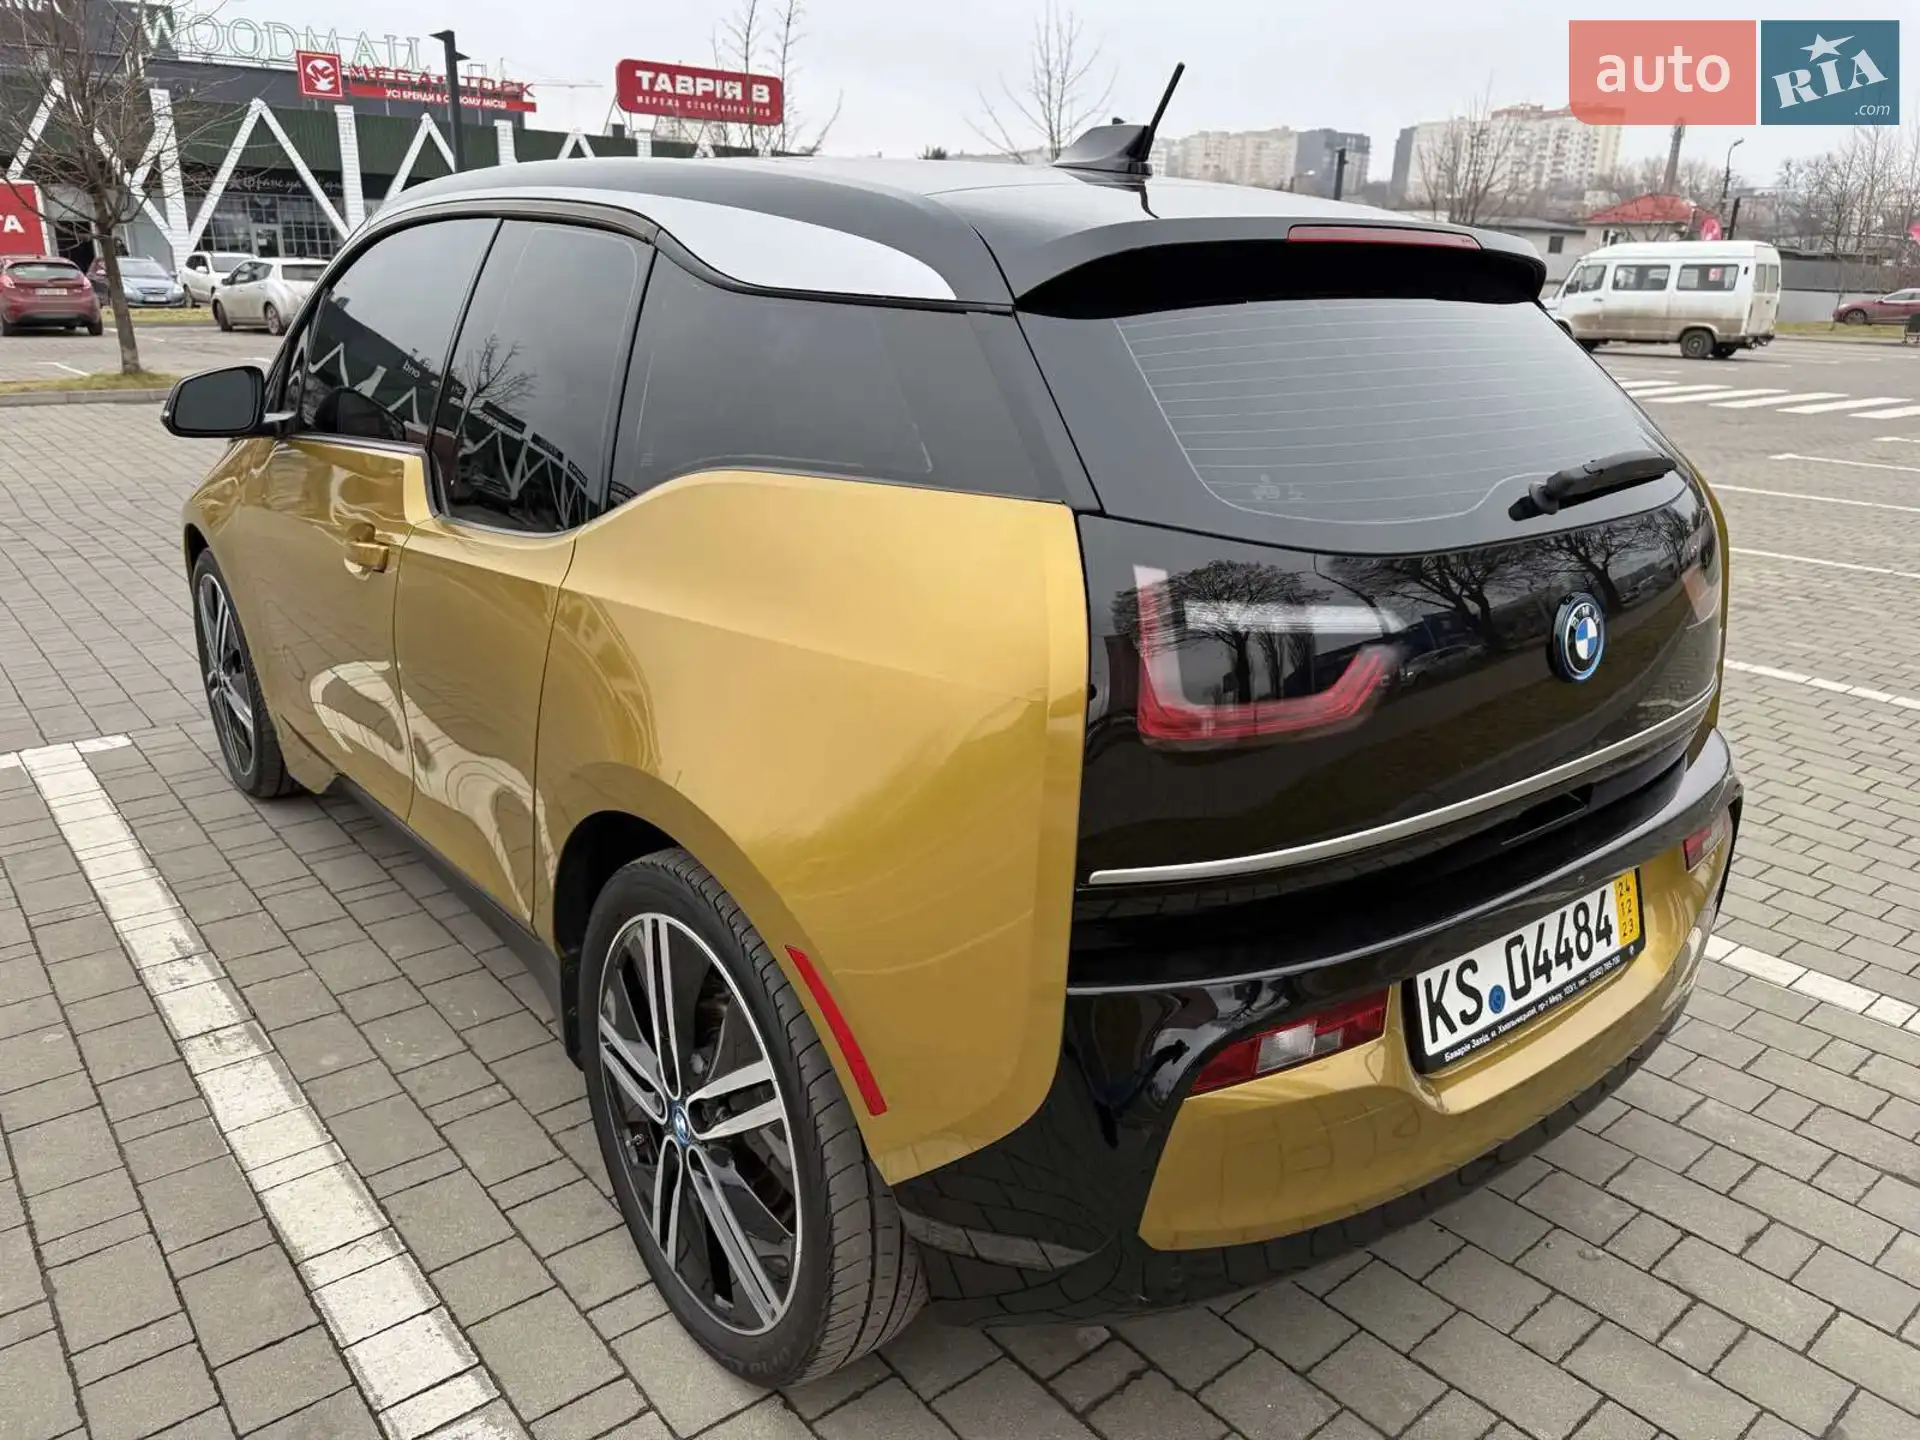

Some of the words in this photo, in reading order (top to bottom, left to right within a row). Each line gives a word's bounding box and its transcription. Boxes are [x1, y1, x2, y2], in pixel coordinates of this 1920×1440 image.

[634, 70, 743, 101] ТАВРІЯ
[752, 83, 771, 104] В
[1619, 876, 1631, 897] 24
[1621, 898, 1632, 917] 12
[1424, 959, 1484, 1044] KS
[1504, 889, 1613, 1001] 04484
